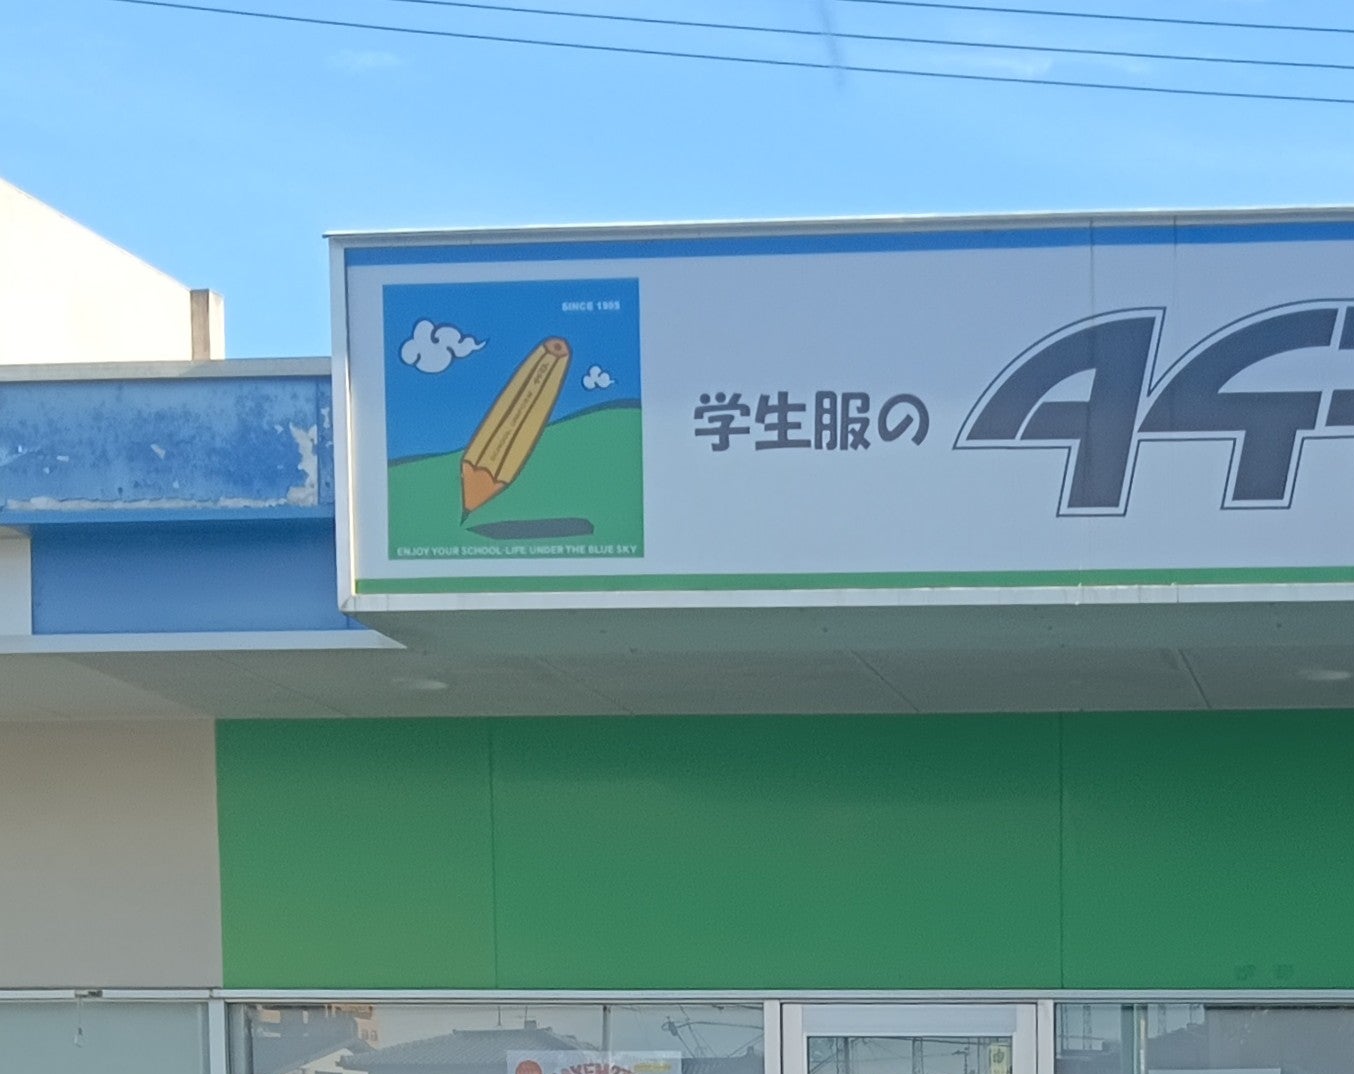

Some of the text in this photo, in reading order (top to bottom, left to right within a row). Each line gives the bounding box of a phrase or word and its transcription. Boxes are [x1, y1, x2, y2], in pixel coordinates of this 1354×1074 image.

[562, 301, 593, 311] SINCE
[694, 390, 930, 452] 学生服の
[431, 547, 460, 556] YOUR
[529, 546, 563, 555] UNDER
[564, 546, 586, 555] THE
[588, 545, 614, 554] BLUE
[616, 545, 637, 554] SKY
